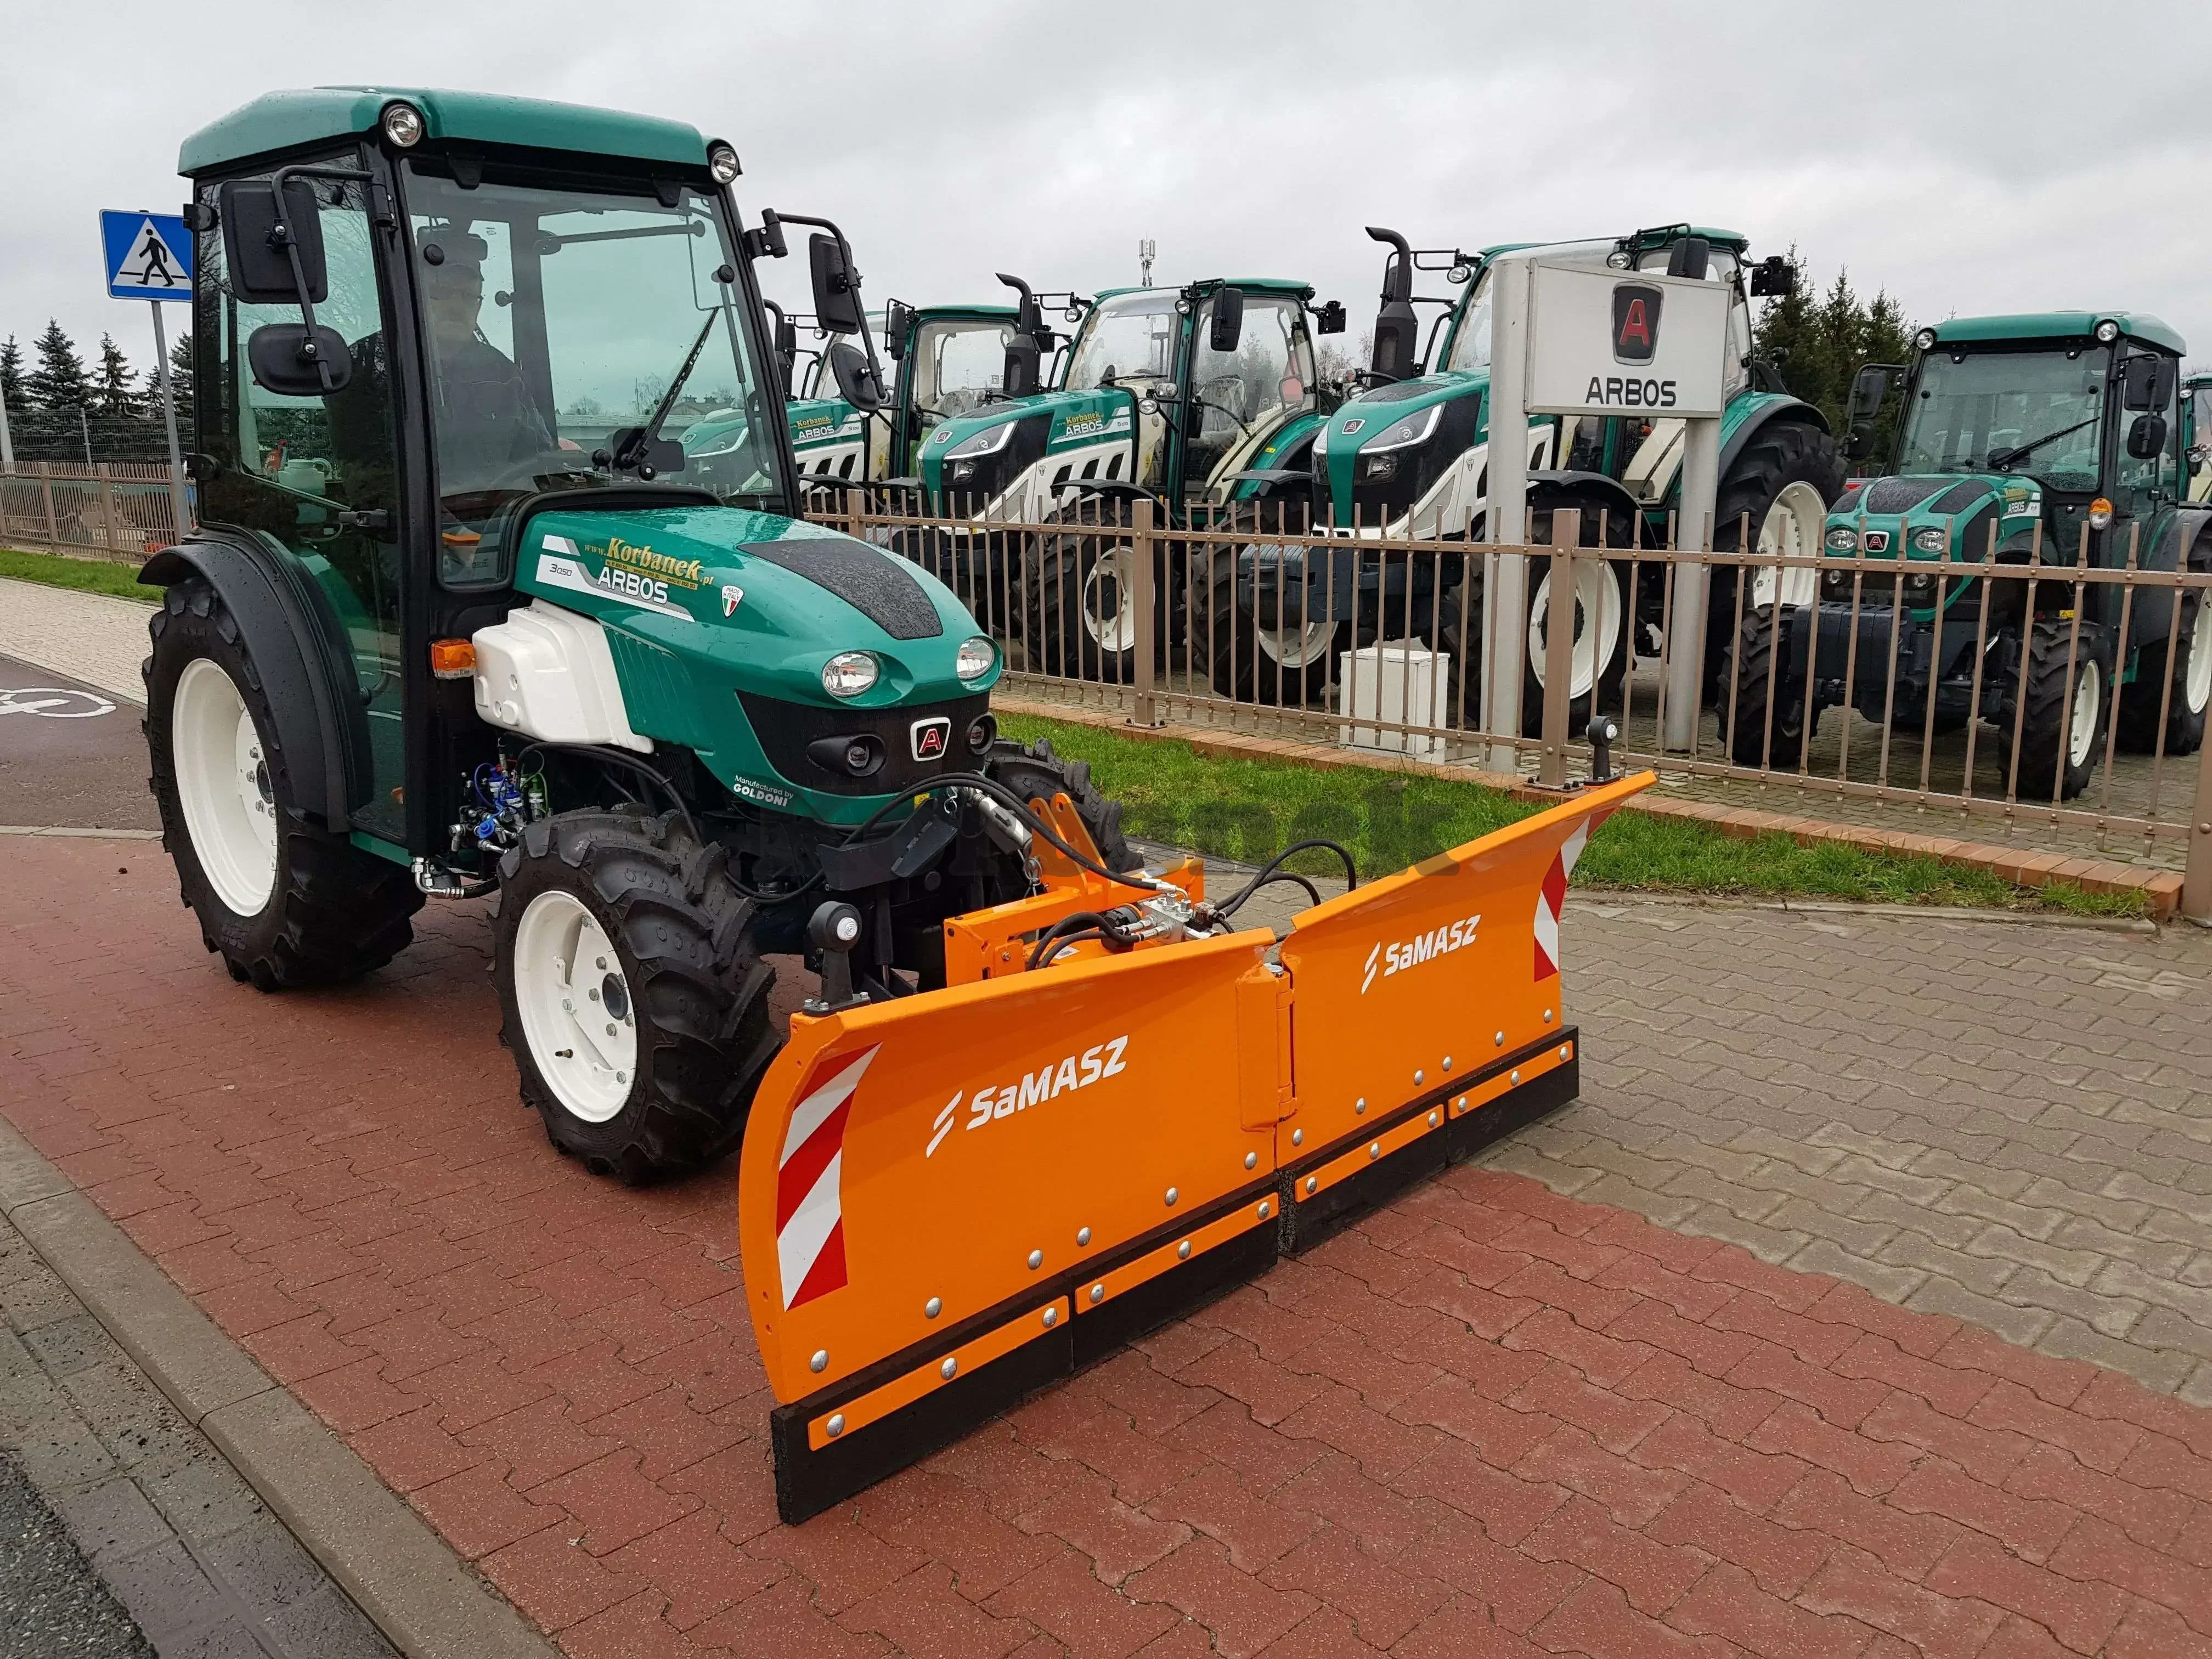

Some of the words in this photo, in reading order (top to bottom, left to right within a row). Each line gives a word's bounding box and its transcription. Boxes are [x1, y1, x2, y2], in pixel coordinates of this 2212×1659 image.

[1619, 298, 1650, 347] A
[1585, 376, 1677, 407] ARBOS
[799, 425, 834, 440] ARBOS
[1066, 420, 1103, 437] ARBOS
[549, 563, 572, 576] 3050
[597, 567, 668, 604] ARBOS
[919, 728, 941, 753] A
[733, 783, 788, 806] GOLDONI
[735, 775, 783, 795] Manufactured
[785, 791, 794, 799] by
[1384, 914, 1481, 977] SaMASZ
[966, 1035, 1128, 1131] SaMASZ
